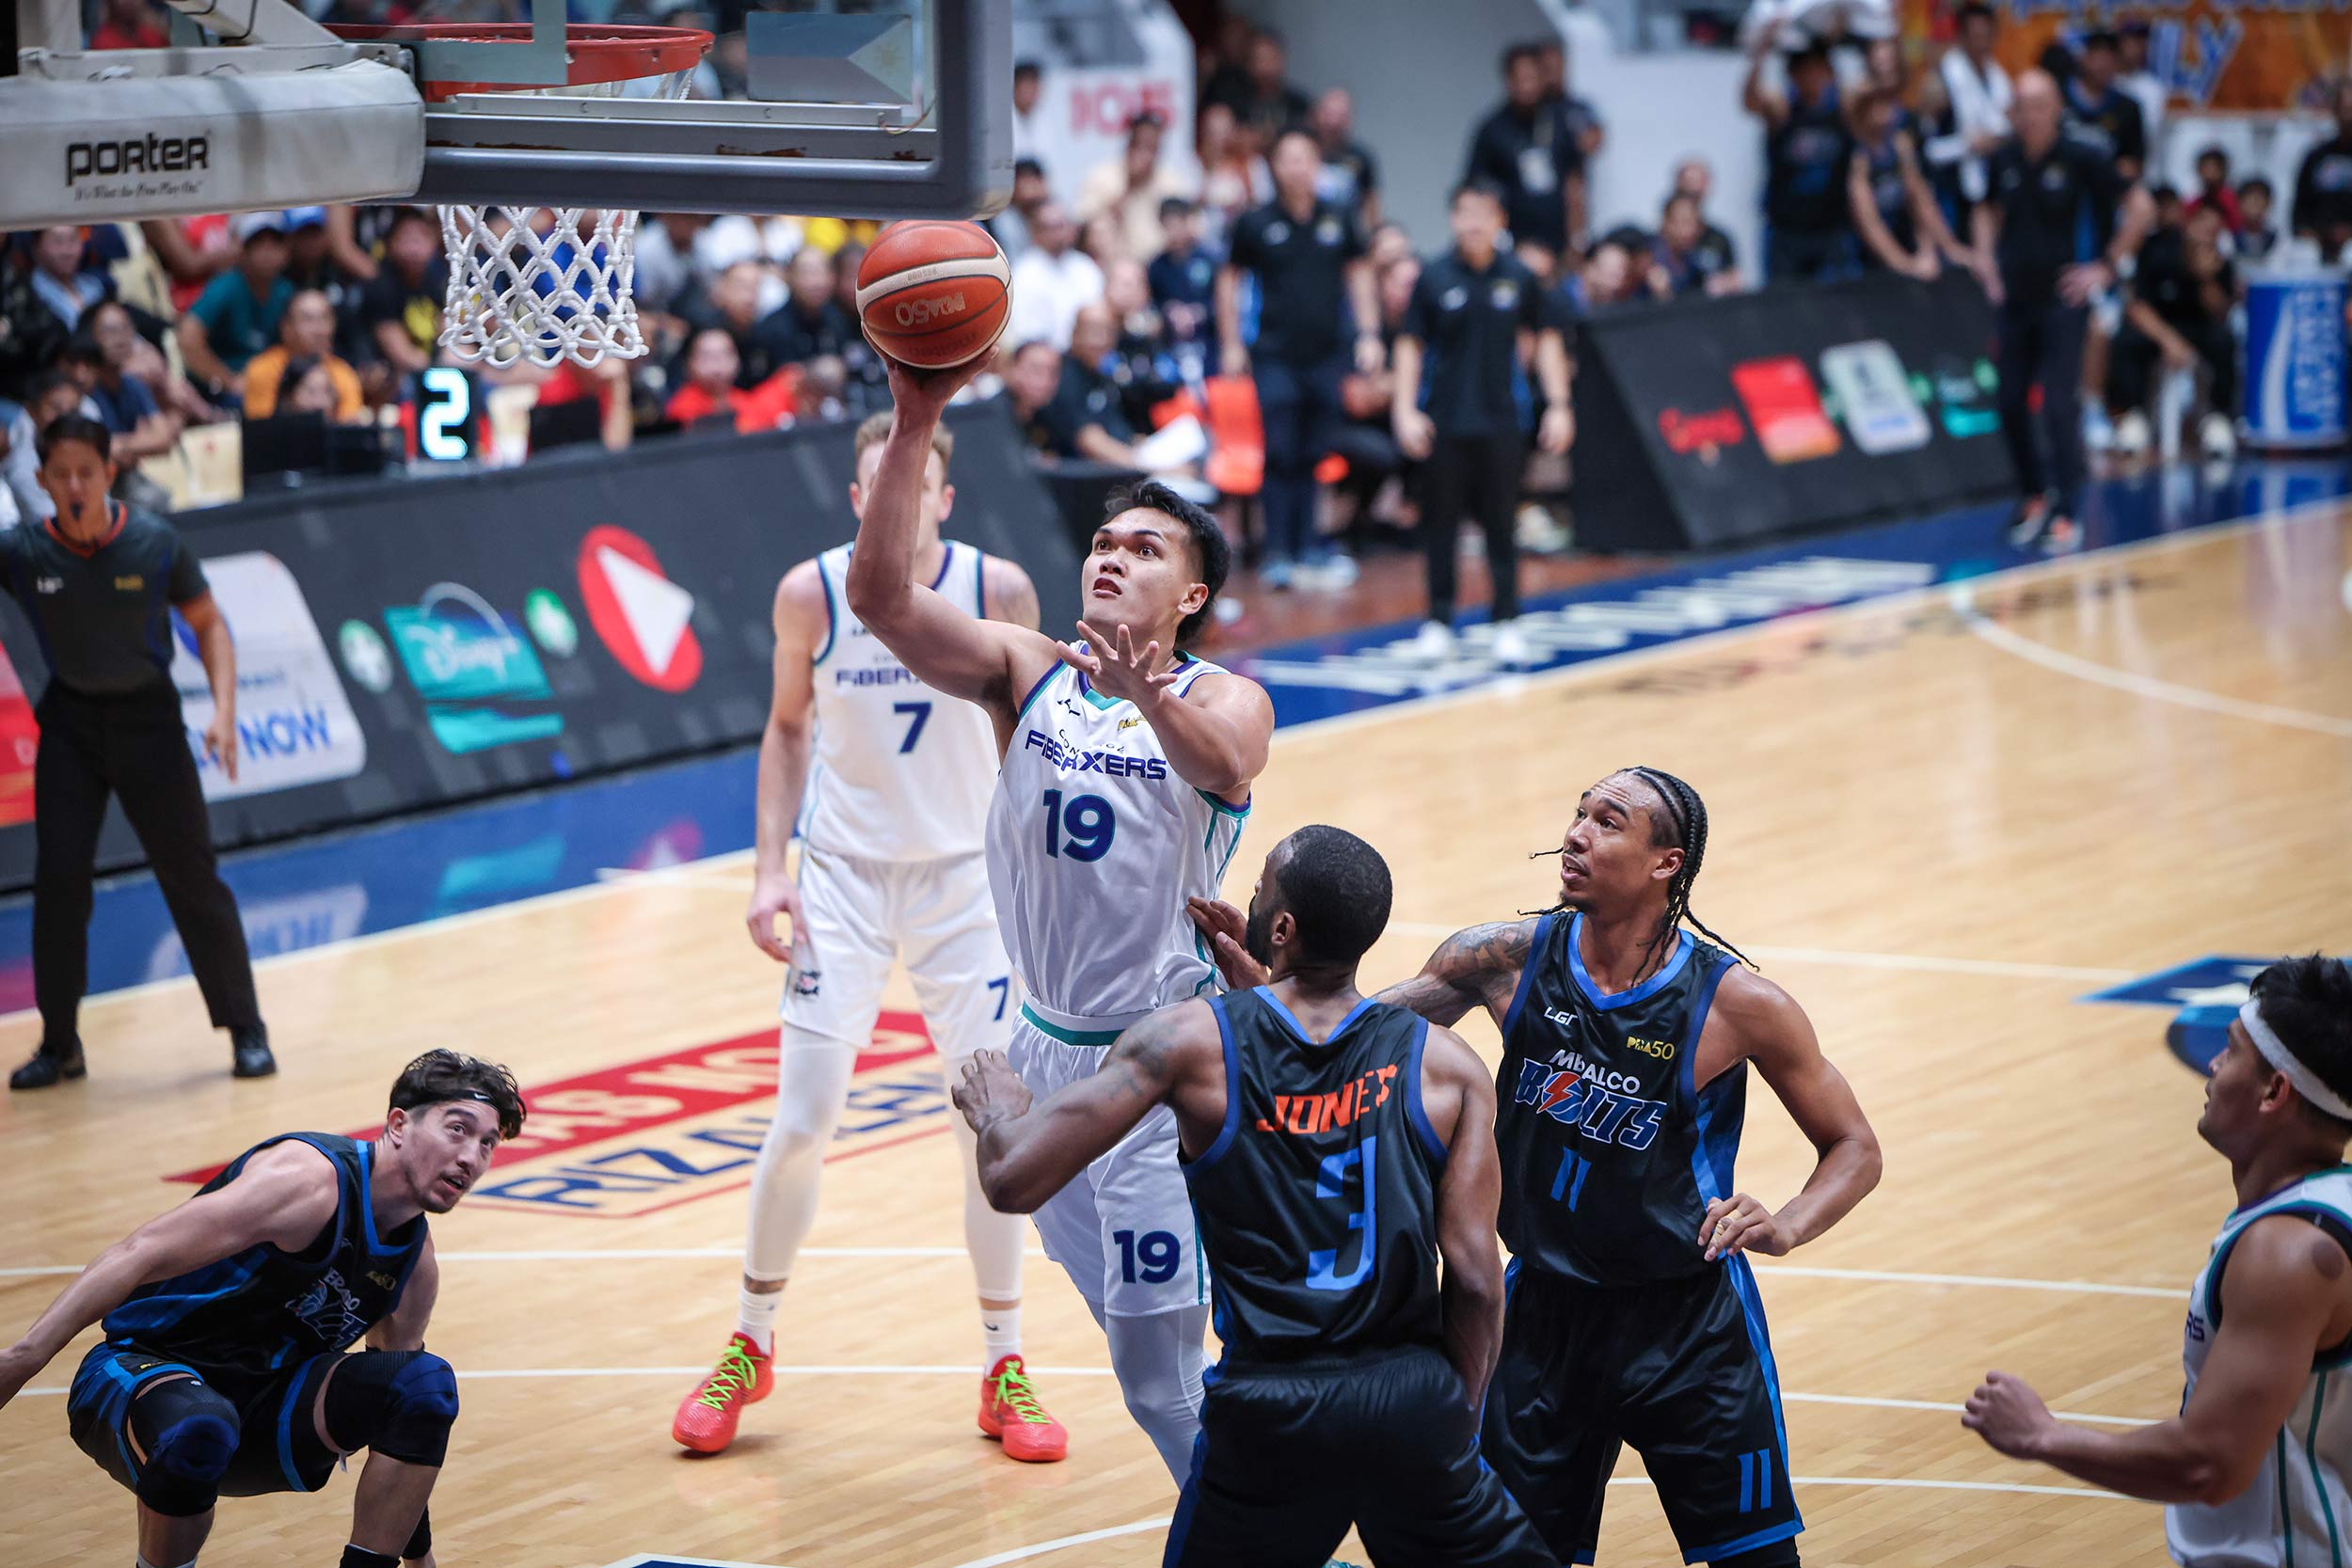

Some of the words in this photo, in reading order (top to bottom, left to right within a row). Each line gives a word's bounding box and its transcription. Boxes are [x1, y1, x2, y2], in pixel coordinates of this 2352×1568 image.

[421, 368, 469, 461] 2
[893, 701, 932, 754] 7
[1042, 788, 1117, 863] 19
[987, 976, 1009, 1022] 7
[1256, 1064, 1398, 1134] JONES
[1550, 1145, 1592, 1212] 11
[1306, 1135, 1376, 1291] 3
[1112, 1229, 1181, 1284] 19
[1737, 1448, 1772, 1513] 11
